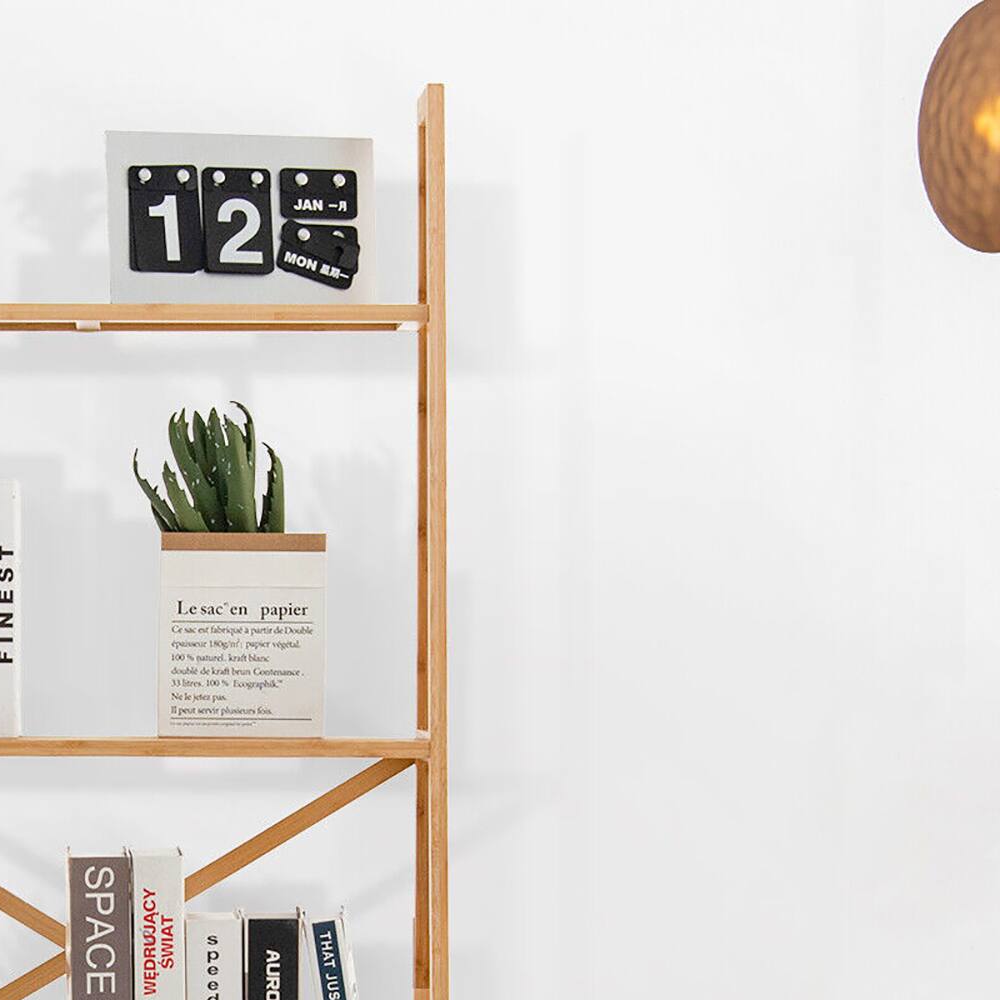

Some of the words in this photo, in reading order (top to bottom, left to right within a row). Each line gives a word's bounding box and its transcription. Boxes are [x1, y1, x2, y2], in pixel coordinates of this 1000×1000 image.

[293, 198, 323, 211] JAN
[283, 251, 318, 272] MON
[177, 600, 197, 616] Le
[230, 605, 248, 616] en
[261, 603, 308, 620] papier
[171, 625, 182, 634] Ce
[184, 626, 196, 634] sac
[251, 626, 272, 636] partir
[273, 625, 283, 634] de
[284, 625, 313, 635] Double
[246, 640, 270, 650] papier
[171, 653, 185, 661] 100
[228, 653, 247, 662] kraft
[248, 653, 270, 662] blanc
[200, 667, 210, 676] de
[211, 667, 229, 676] kraft
[231, 667, 251, 676] brun
[171, 680, 181, 688] 33
[206, 680, 219, 688] 100
[171, 693, 183, 702] Ne
[184, 693, 192, 701] le
[178, 707, 196, 716] peut
[84, 866, 116, 995] SPACE
[160, 915, 174, 969] ŚWIAT
[319, 931, 336, 968] THAT
